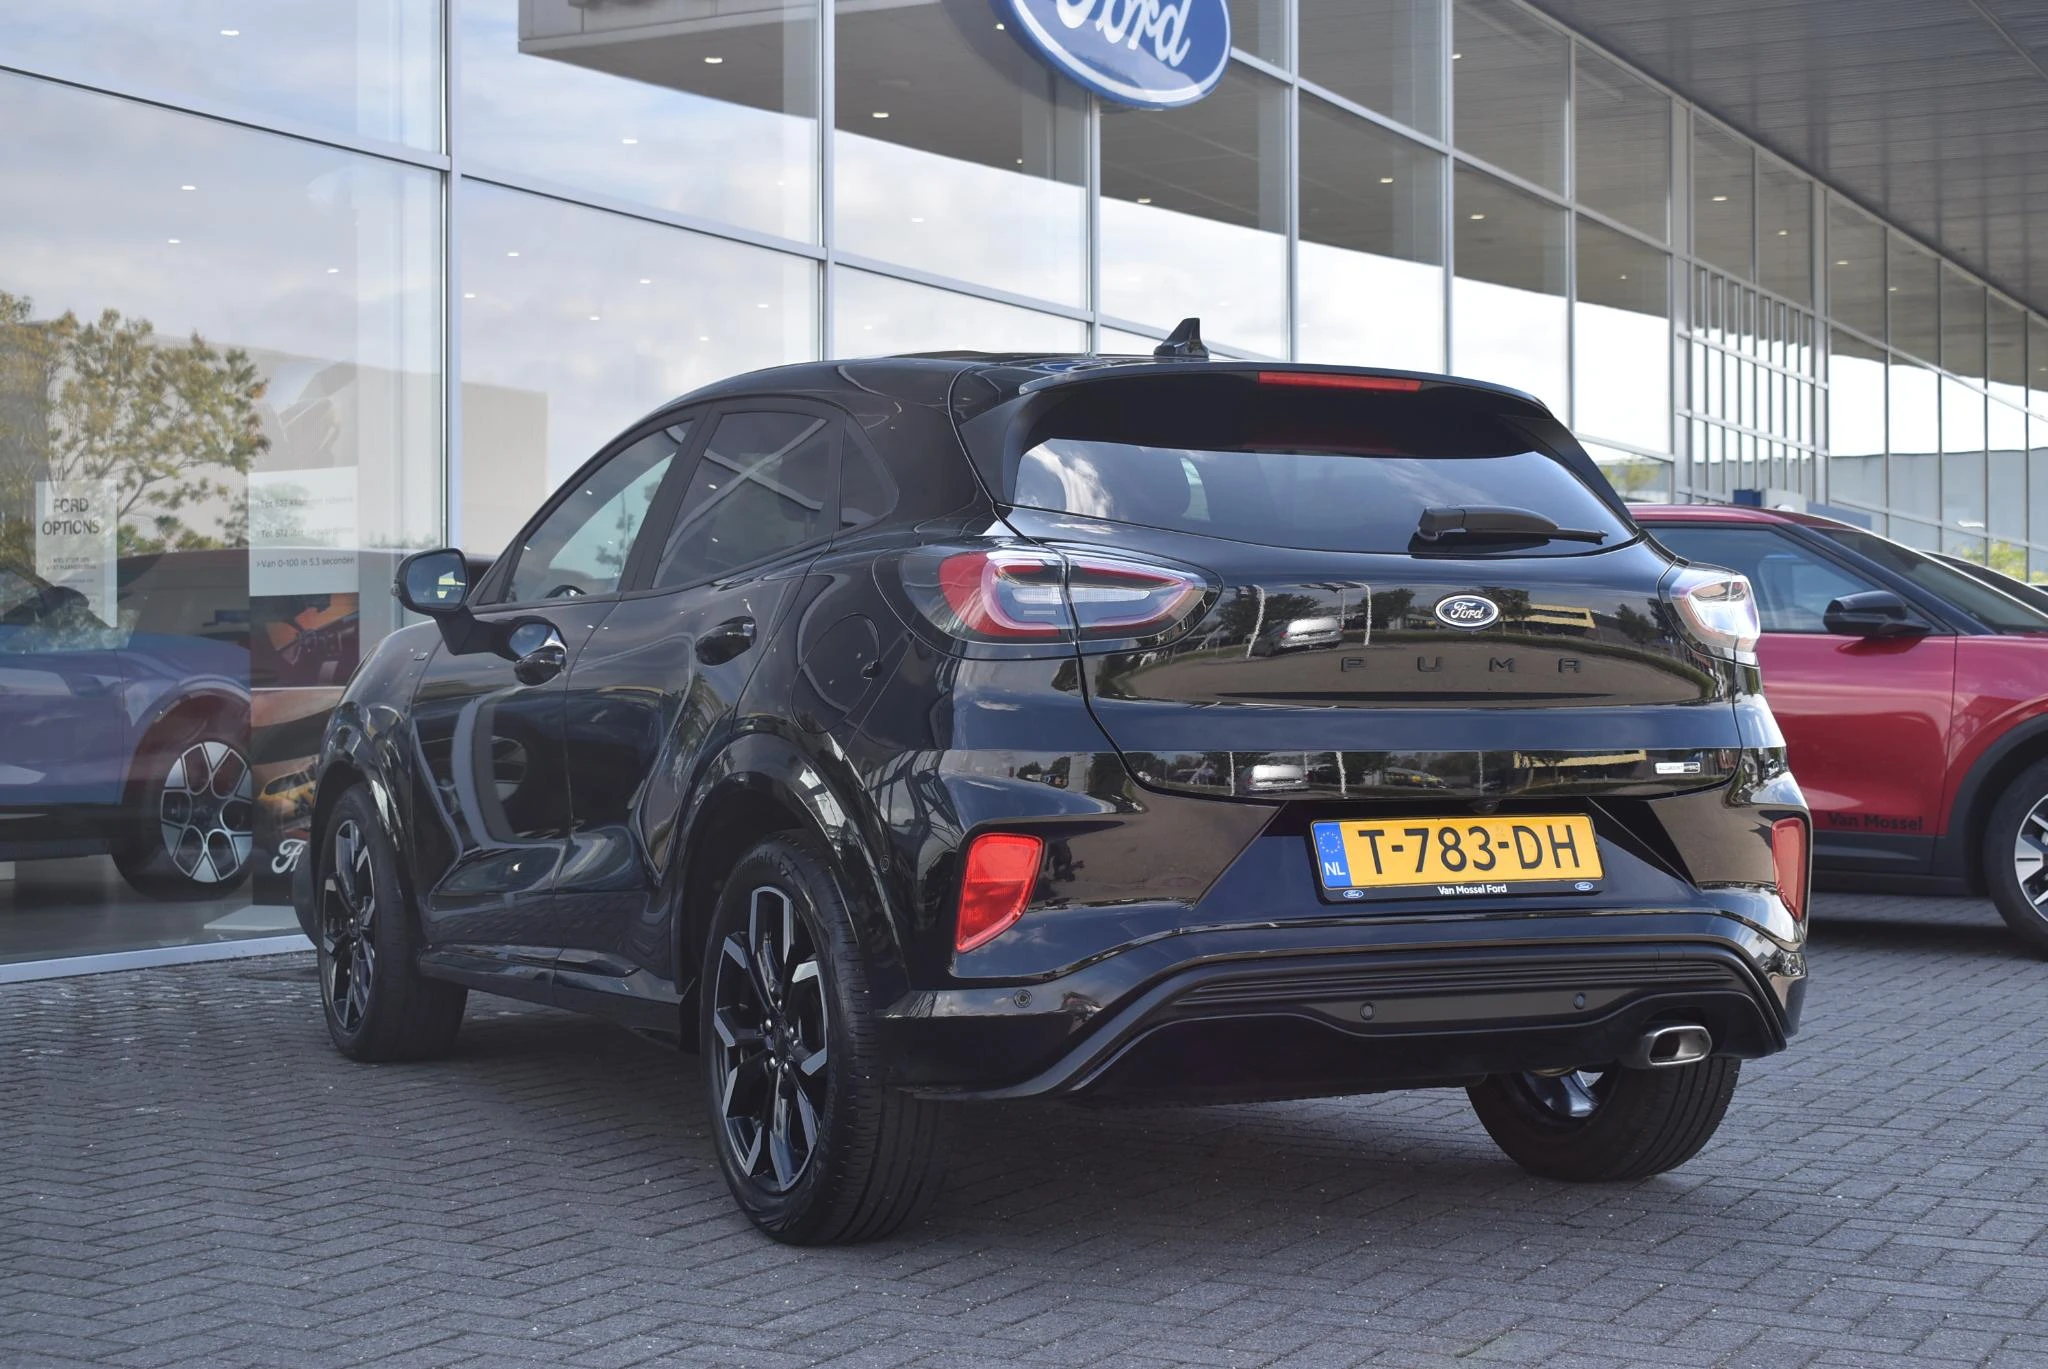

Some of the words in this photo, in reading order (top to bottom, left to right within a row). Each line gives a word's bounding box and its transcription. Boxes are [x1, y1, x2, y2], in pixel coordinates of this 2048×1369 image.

[1057, 0, 1191, 67] ord
[53, 498, 89, 513] FORD
[42, 520, 100, 536] OPTIONS
[1450, 601, 1485, 620] Ford
[1340, 656, 1582, 673] PUMA
[1828, 812, 1858, 827] Van
[1864, 814, 1922, 831] Mossel
[1357, 824, 1581, 875] T-783-DH
[1325, 862, 1346, 877] NL
[1437, 886, 1455, 895] Van
[1455, 884, 1485, 895] Mossel
[1486, 883, 1508, 893] Ford
